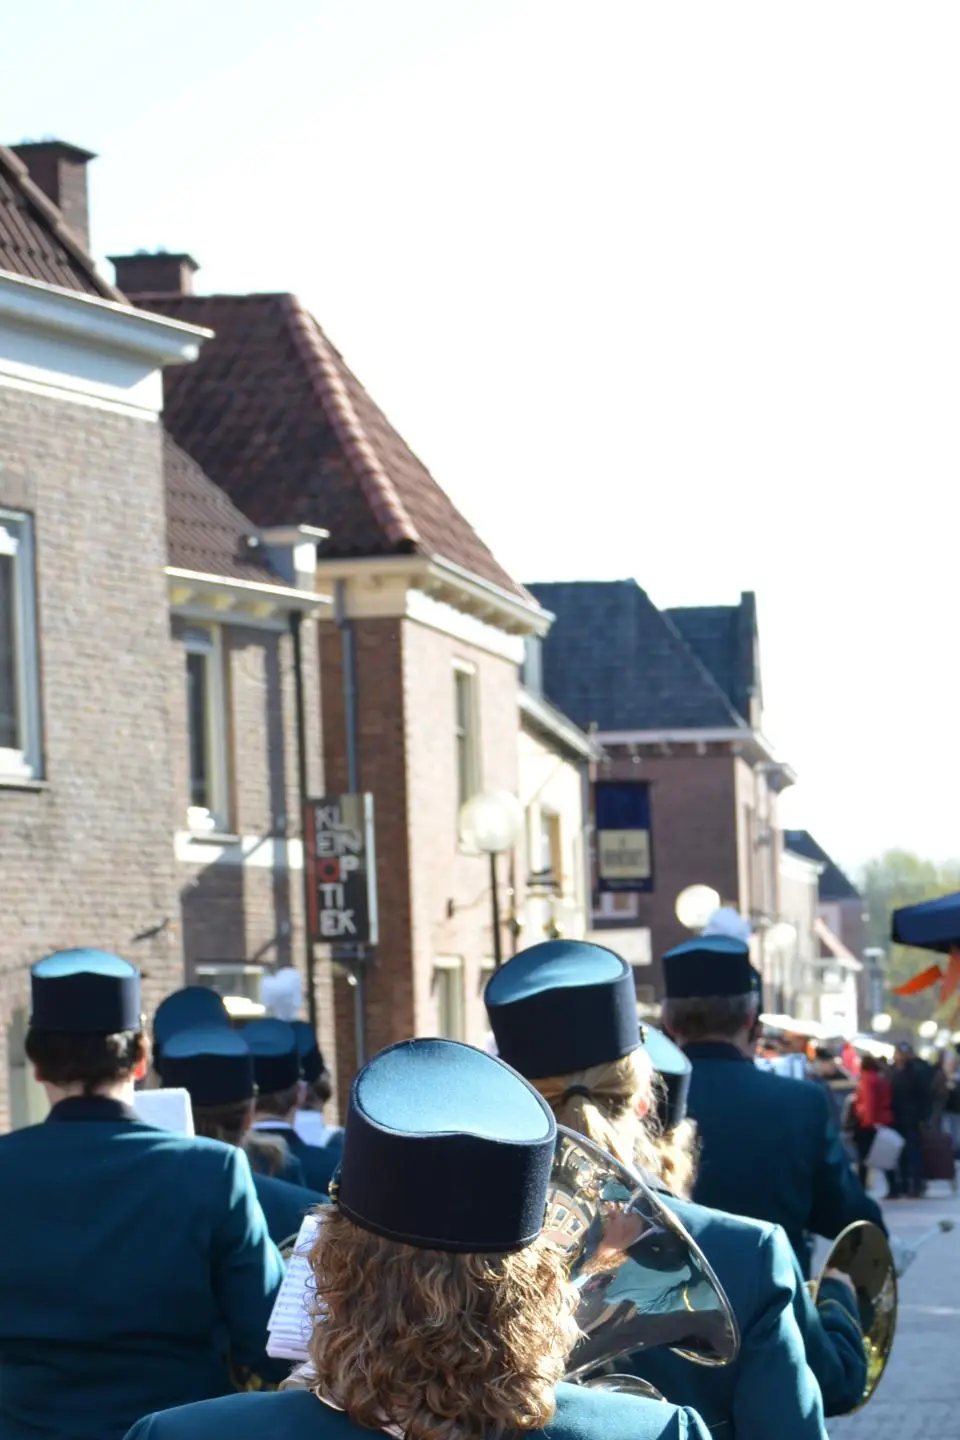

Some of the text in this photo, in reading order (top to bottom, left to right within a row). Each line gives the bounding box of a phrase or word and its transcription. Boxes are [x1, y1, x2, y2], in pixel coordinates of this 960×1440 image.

[318, 855, 360, 883] OP
[319, 883, 345, 909] TI
[320, 909, 357, 937] EK
